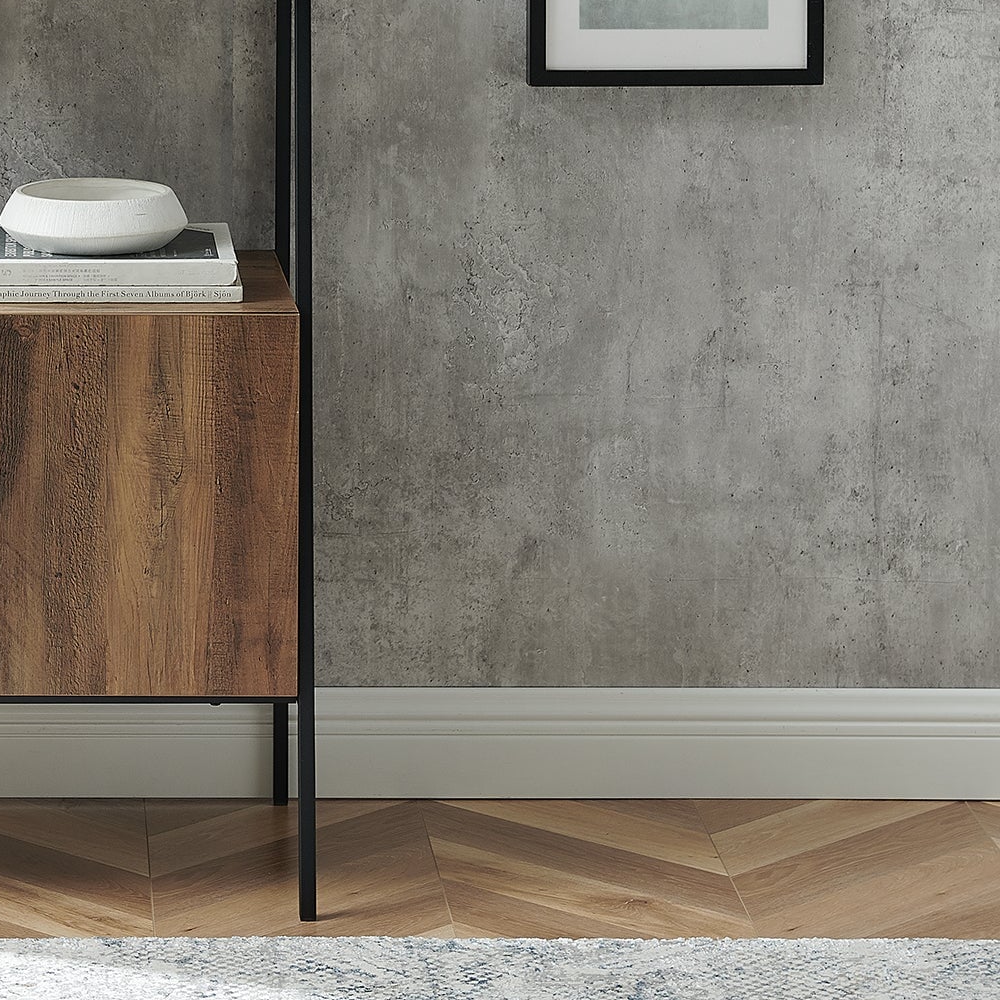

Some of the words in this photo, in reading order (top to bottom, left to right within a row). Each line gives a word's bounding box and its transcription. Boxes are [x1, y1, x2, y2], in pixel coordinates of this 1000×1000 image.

[20, 290, 51, 300] Journey
[52, 290, 86, 299] Through
[87, 290, 99, 298] the
[101, 290, 119, 298] First
[120, 290, 144, 298] Seven
[145, 290, 174, 298] Albums
[175, 290, 184, 298] of
[184, 290, 207, 300] Björk
[213, 290, 232, 300] Sjón
